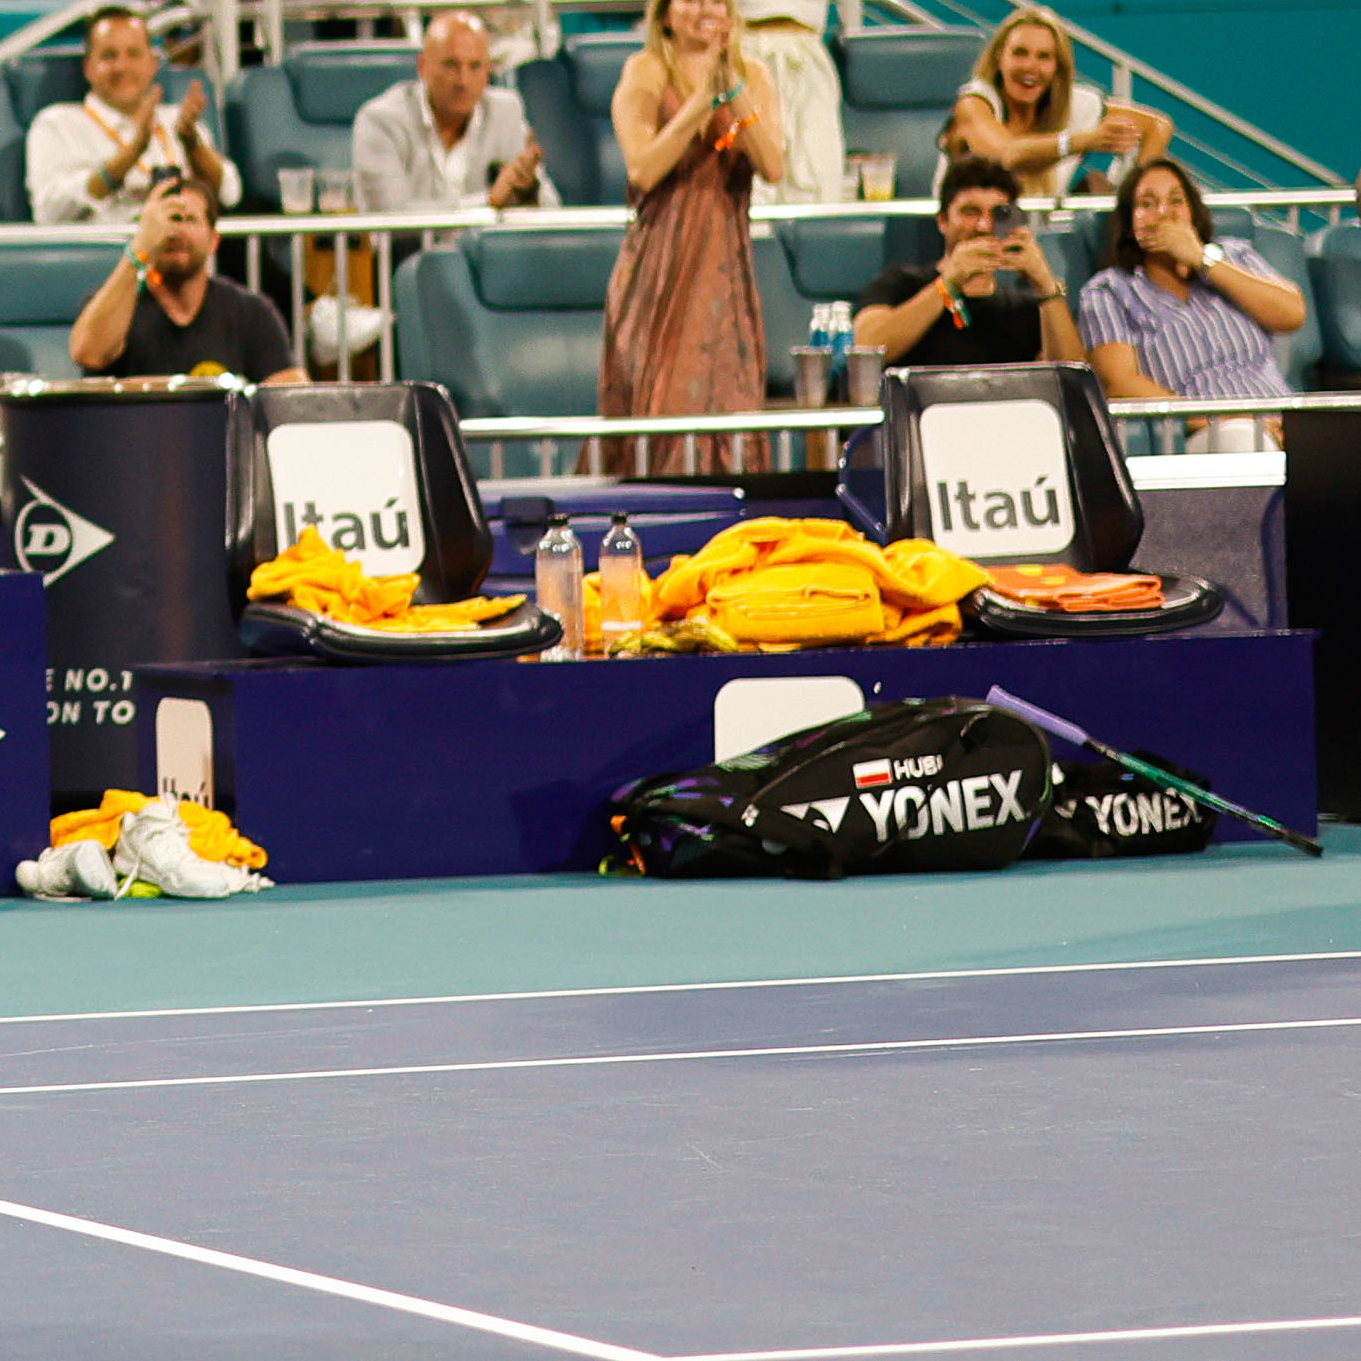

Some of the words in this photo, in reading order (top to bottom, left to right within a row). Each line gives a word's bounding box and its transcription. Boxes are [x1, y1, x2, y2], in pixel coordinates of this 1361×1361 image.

[937, 473, 1061, 532] Itaú
[64, 668, 133, 691] NO.1
[93, 700, 136, 725] TO
[858, 769, 1027, 843] YONEX
